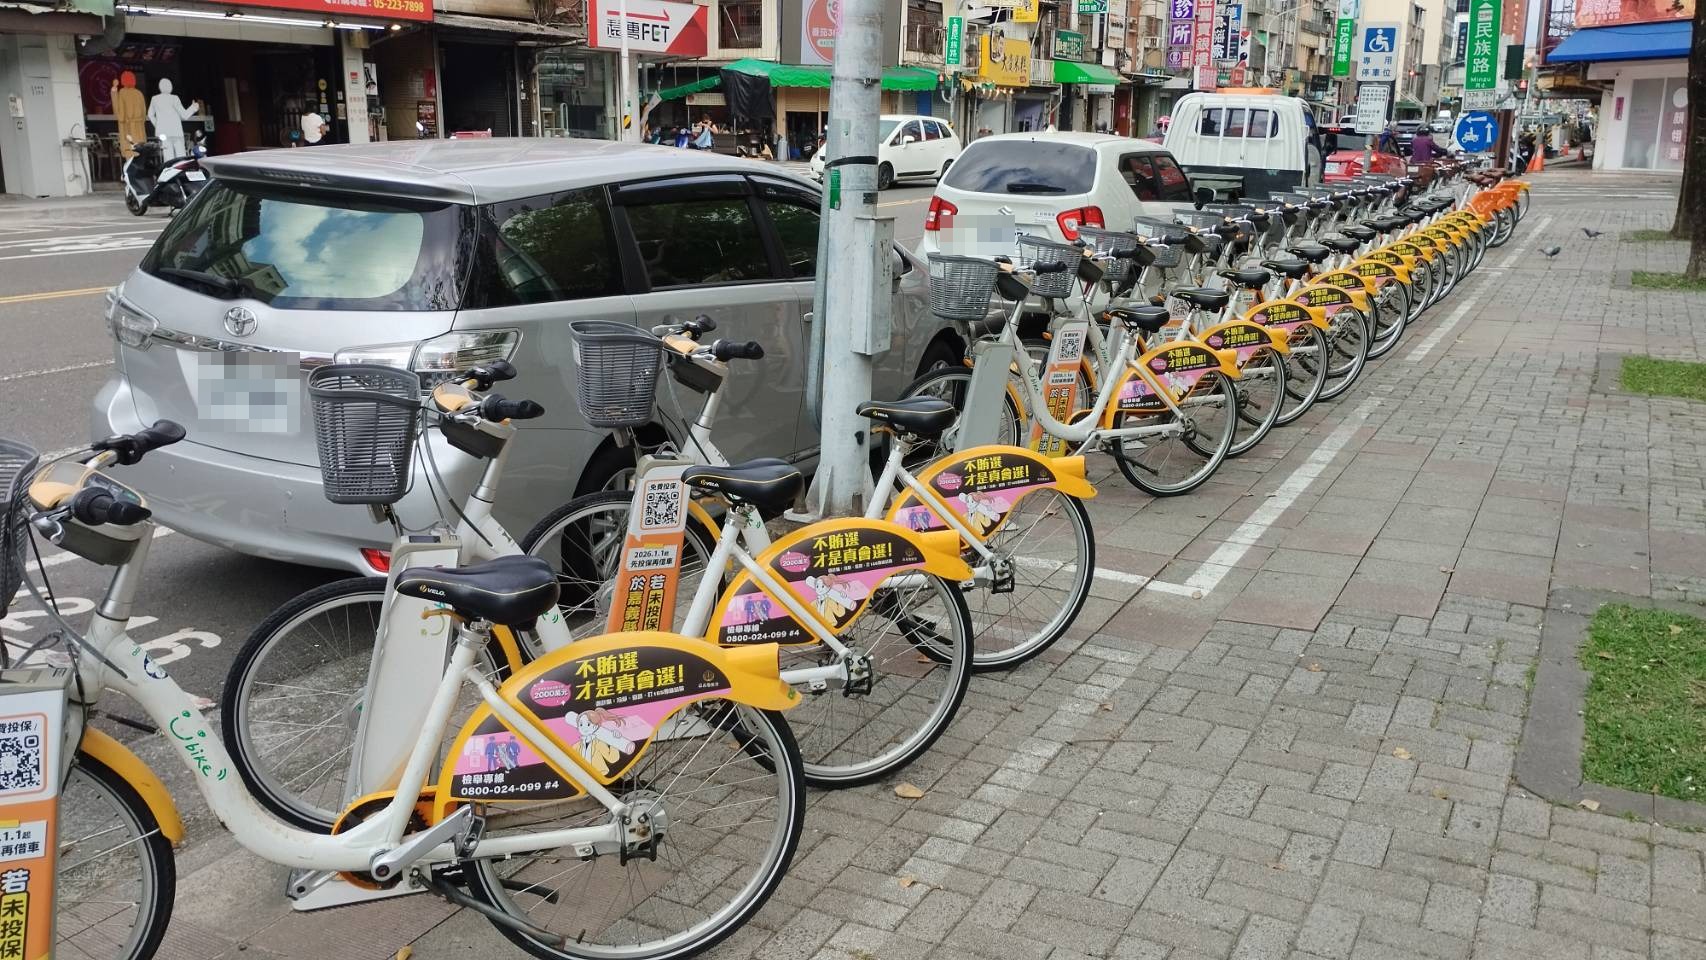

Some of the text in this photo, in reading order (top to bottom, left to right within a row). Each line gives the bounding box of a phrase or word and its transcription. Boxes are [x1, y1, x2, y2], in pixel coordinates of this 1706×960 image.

[1473, 22, 1493, 73] 民族路
[1361, 68, 1391, 78] 停車位
[964, 455, 1003, 472] 不賄選
[964, 465, 1030, 487] 才是真會選!
[812, 531, 859, 551] 不賄選
[813, 541, 892, 569] 才是真會選!
[646, 574, 666, 631] 若未投保
[726, 629, 800, 643] 0800-024-099 #4
[727, 624, 760, 635] 檢舉專線
[575, 651, 639, 679] 不賄選
[575, 664, 684, 700] 才是真會選!
[461, 780, 560, 796] 0800-024-099 #4
[462, 773, 505, 785] 檢舉專線
